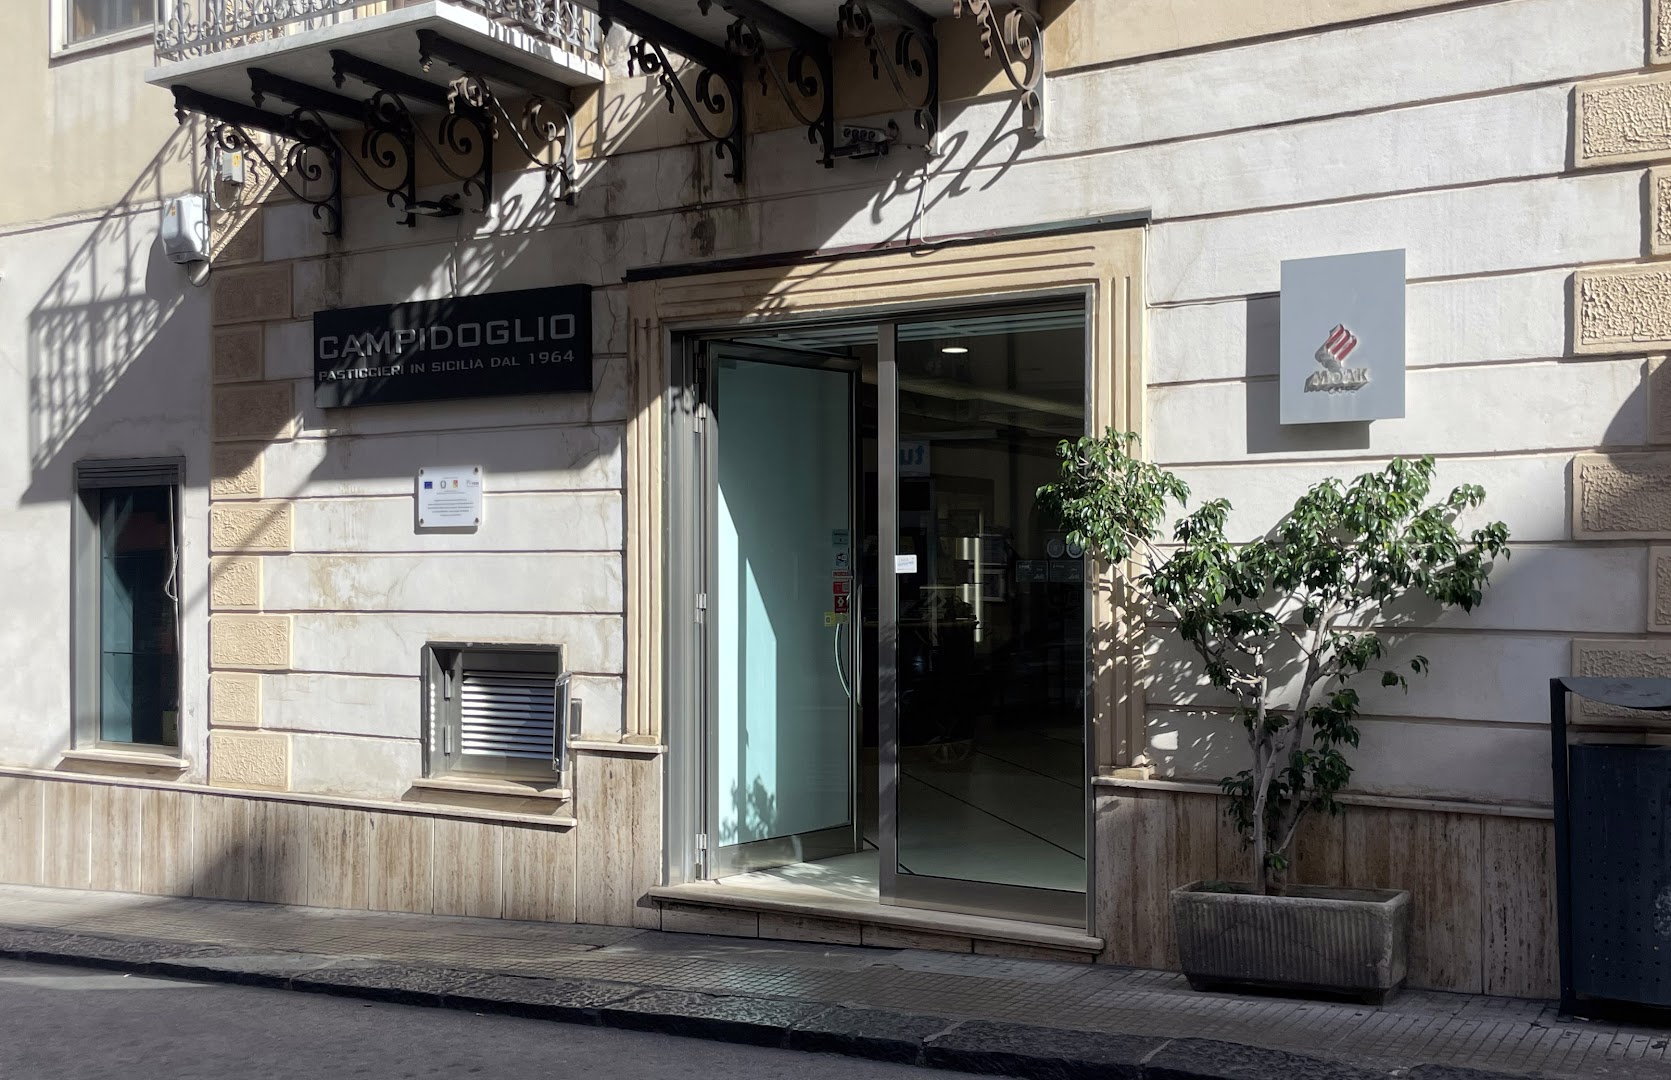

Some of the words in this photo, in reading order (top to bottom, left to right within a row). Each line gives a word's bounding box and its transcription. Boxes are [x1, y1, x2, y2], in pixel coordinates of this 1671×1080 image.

[319, 313, 576, 359] CAMPIDOGLIO
[318, 364, 404, 381] PASTICCIERI
[410, 362, 425, 374] IN
[431, 358, 484, 372] SICILIA
[490, 356, 521, 368] DAL
[529, 349, 575, 365] 1964
